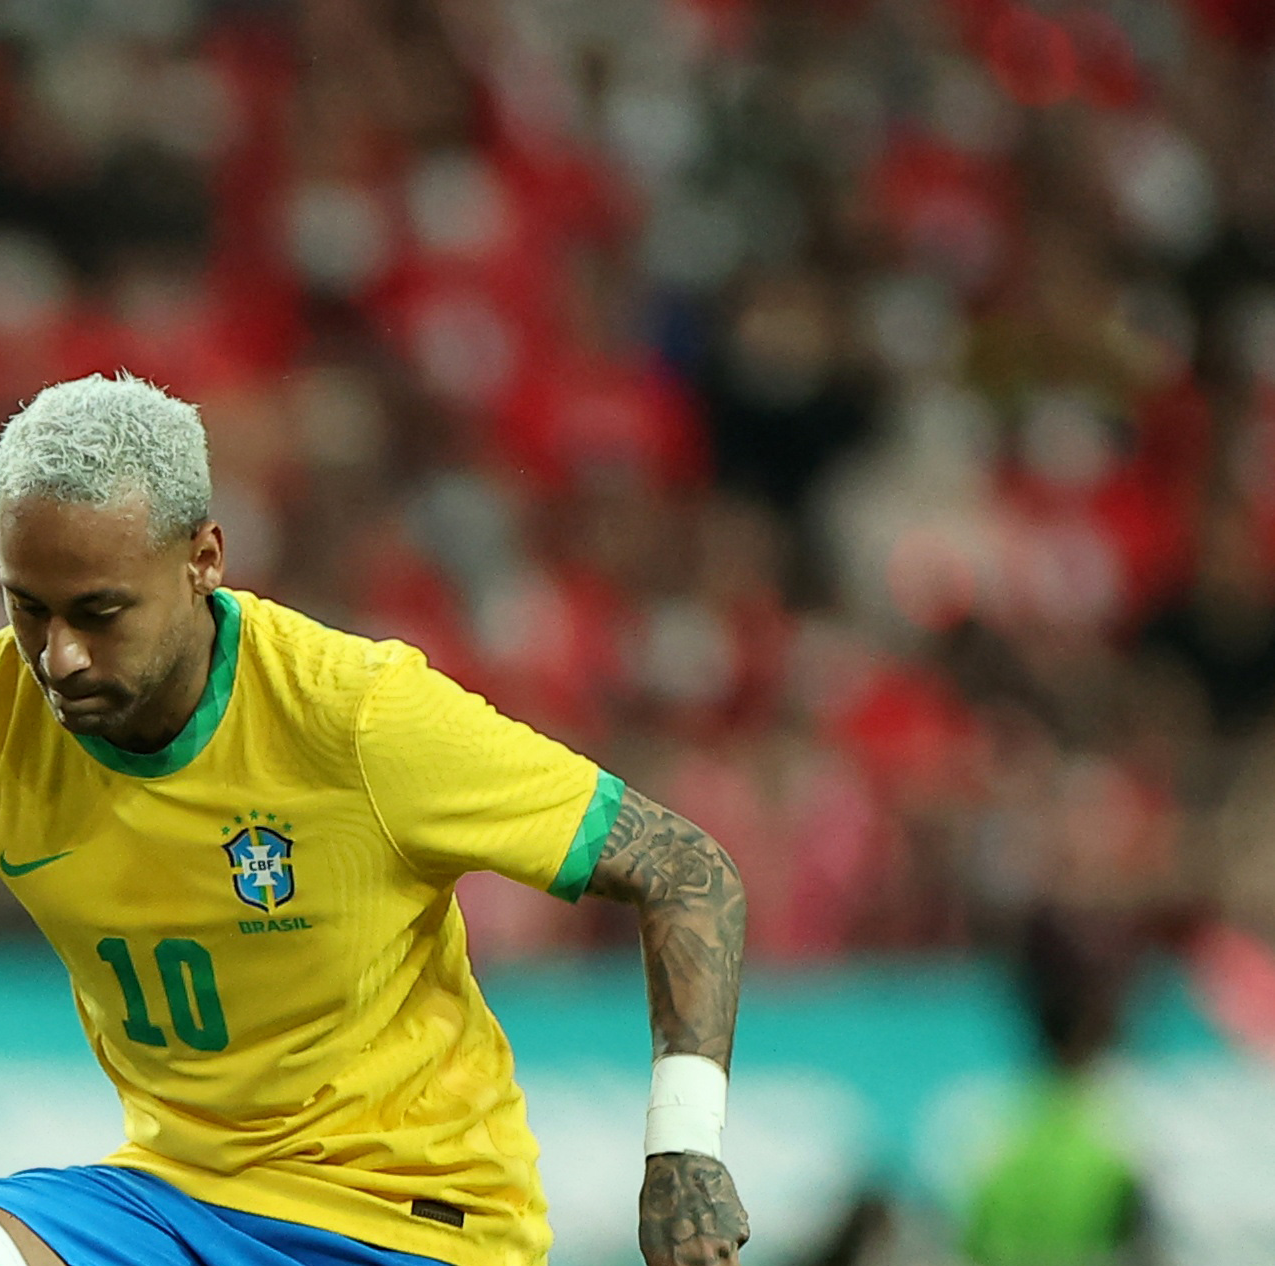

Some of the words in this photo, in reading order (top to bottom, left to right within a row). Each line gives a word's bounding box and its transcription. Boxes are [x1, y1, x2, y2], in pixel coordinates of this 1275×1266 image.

[249, 859, 275, 872] CBF
[238, 917, 313, 934] BRASIL
[96, 937, 230, 1052] 10
